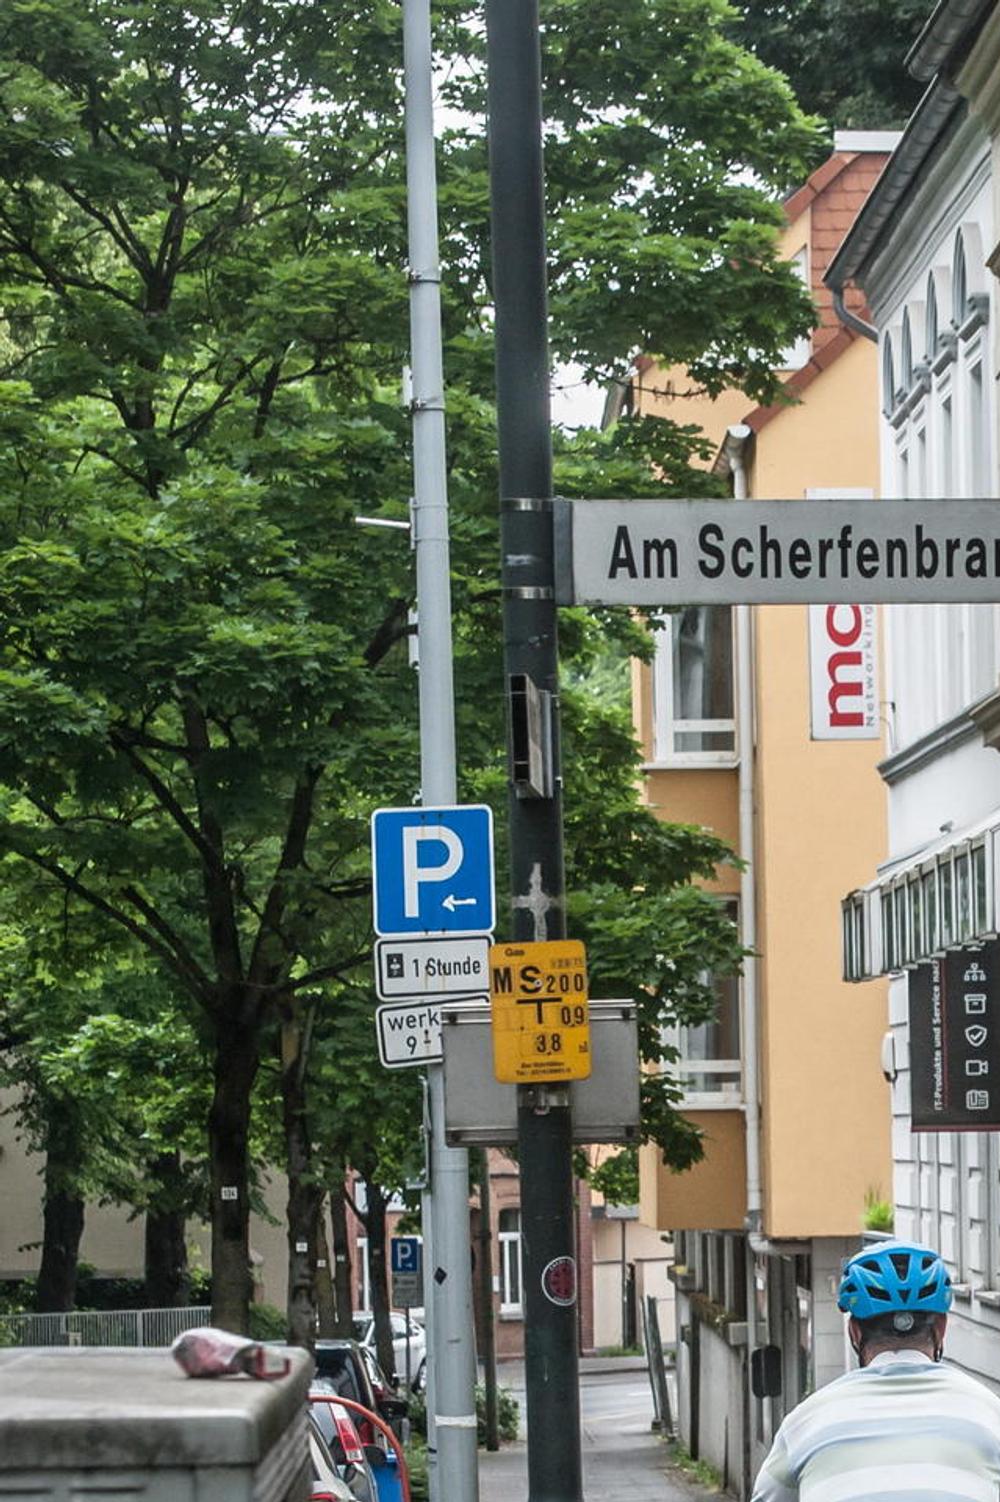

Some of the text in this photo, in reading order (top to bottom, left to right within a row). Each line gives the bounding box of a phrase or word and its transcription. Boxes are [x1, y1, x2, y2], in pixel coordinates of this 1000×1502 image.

[608, 524, 679, 579] Am
[402, 825, 465, 918] P
[412, 955, 481, 978] 1 Stunde
[387, 1008, 440, 1032] werk
[516, 997, 563, 1025] T
